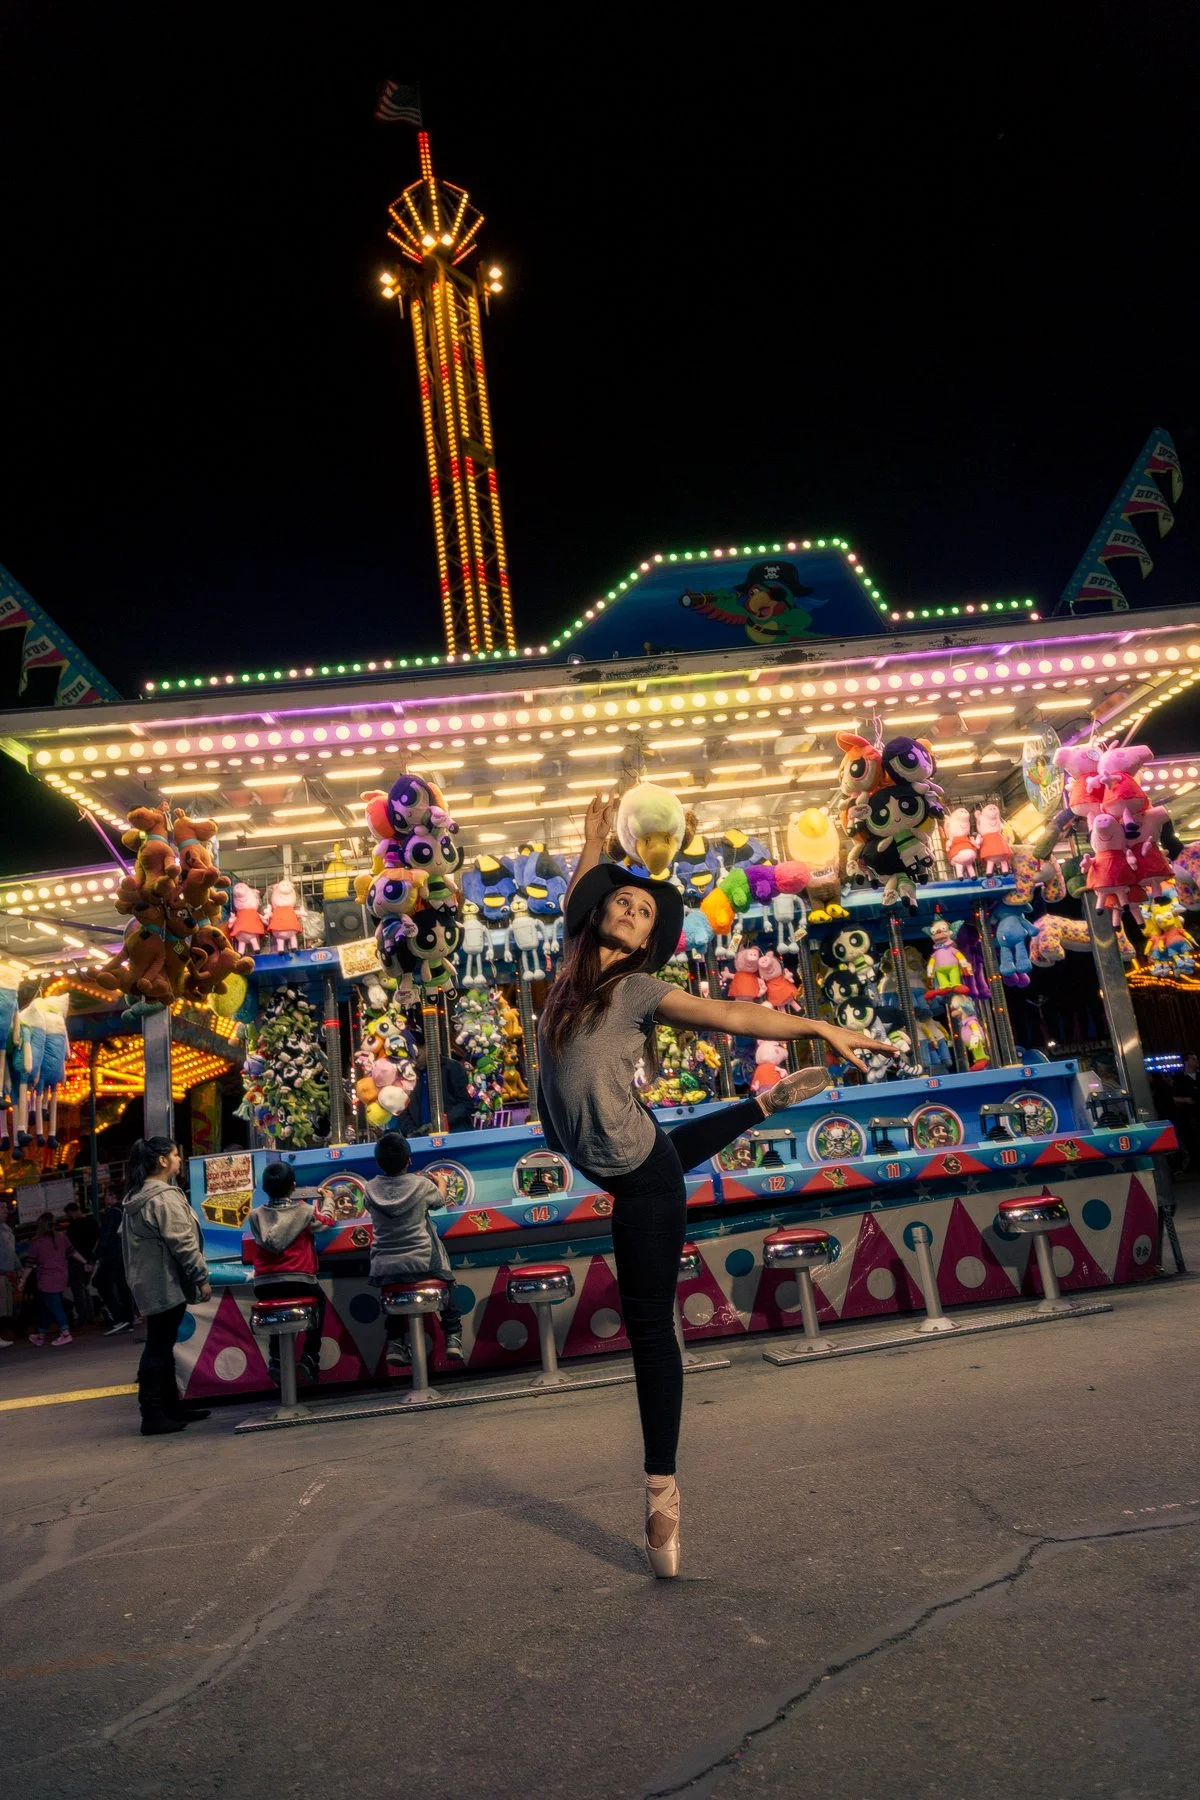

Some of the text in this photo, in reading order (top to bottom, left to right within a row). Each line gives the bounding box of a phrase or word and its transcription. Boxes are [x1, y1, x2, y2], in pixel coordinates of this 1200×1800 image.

[1040, 779, 1061, 809] NEST
[432, 1137, 443, 1146] 15
[1119, 1136, 1130, 1151] 9
[1000, 1149, 1018, 1164] 10
[886, 1162, 900, 1178] 11
[768, 1175, 785, 1191] 12
[531, 1206, 550, 1222] 14
